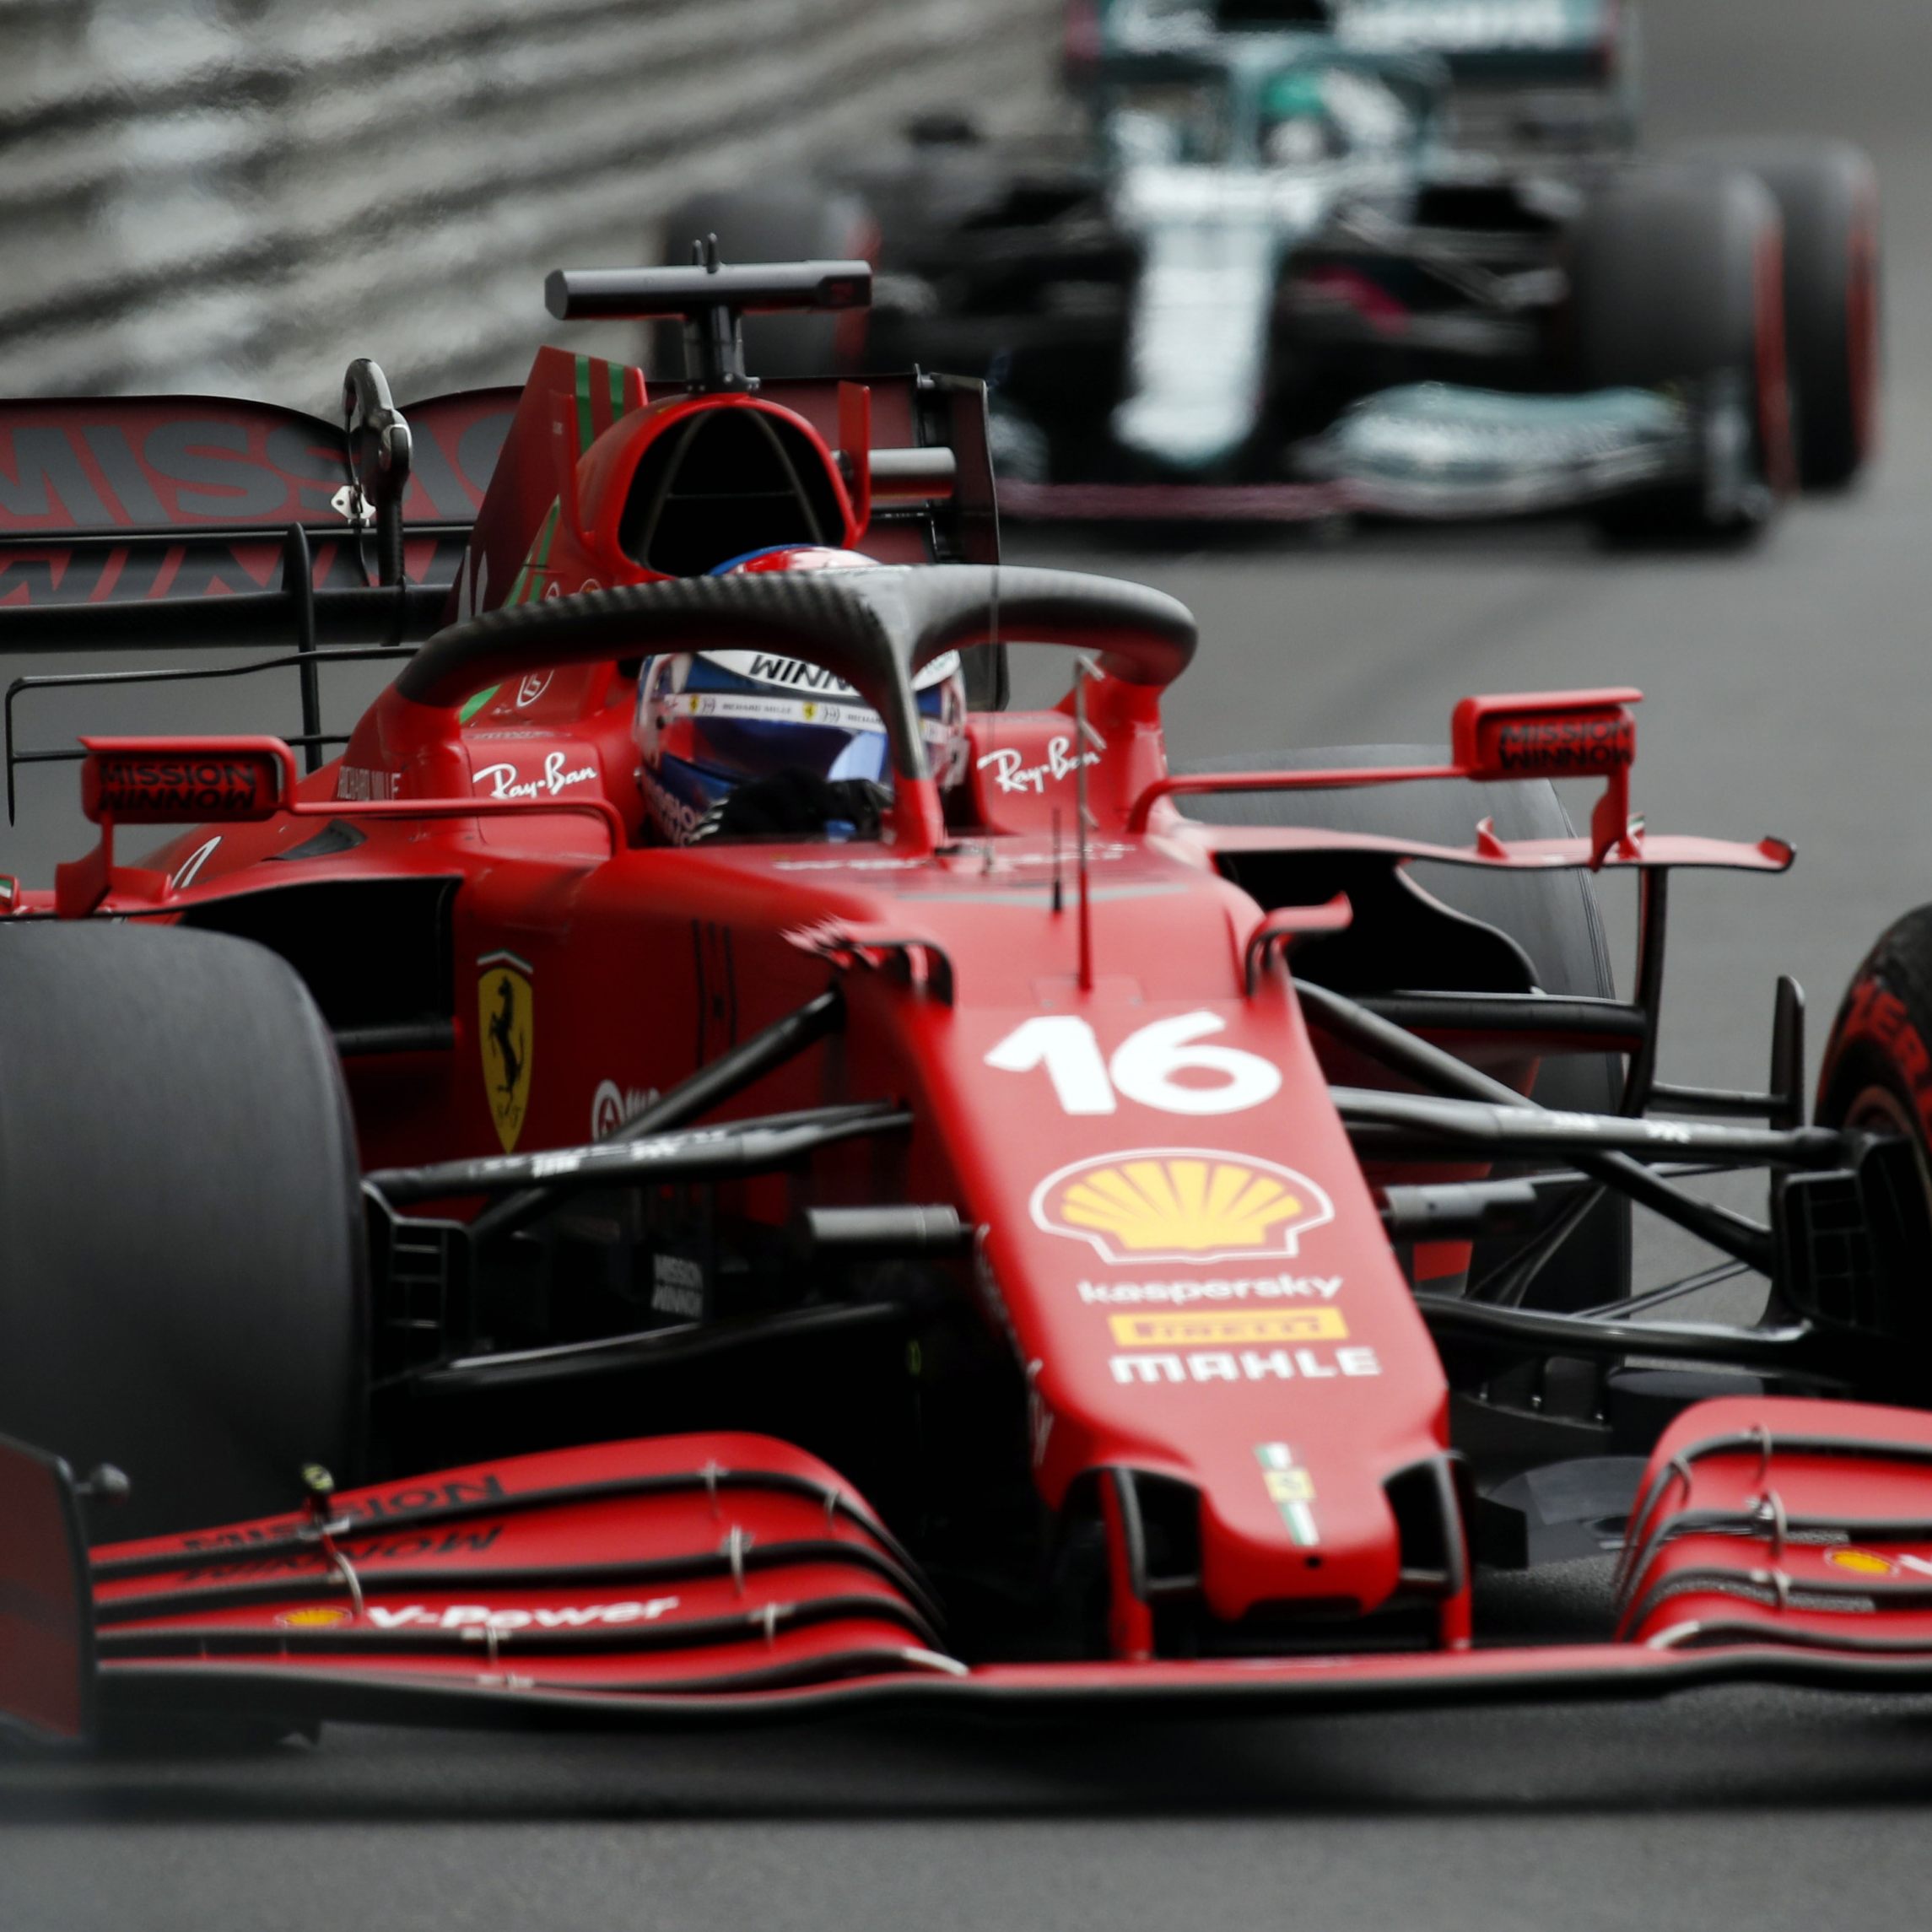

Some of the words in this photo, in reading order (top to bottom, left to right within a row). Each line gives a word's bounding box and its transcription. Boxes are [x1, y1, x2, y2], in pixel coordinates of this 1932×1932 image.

[1501, 720, 1632, 743] MISSION
[100, 761, 256, 786] MISSION
[472, 751, 597, 799] Ray-Ban
[977, 736, 1101, 792] Ray-Ban
[983, 1007, 1282, 1114] 16
[1077, 1271, 1344, 1305] kaspersky
[1108, 1346, 1382, 1383] MAHLE
[368, 1595, 678, 1628] V-Power
